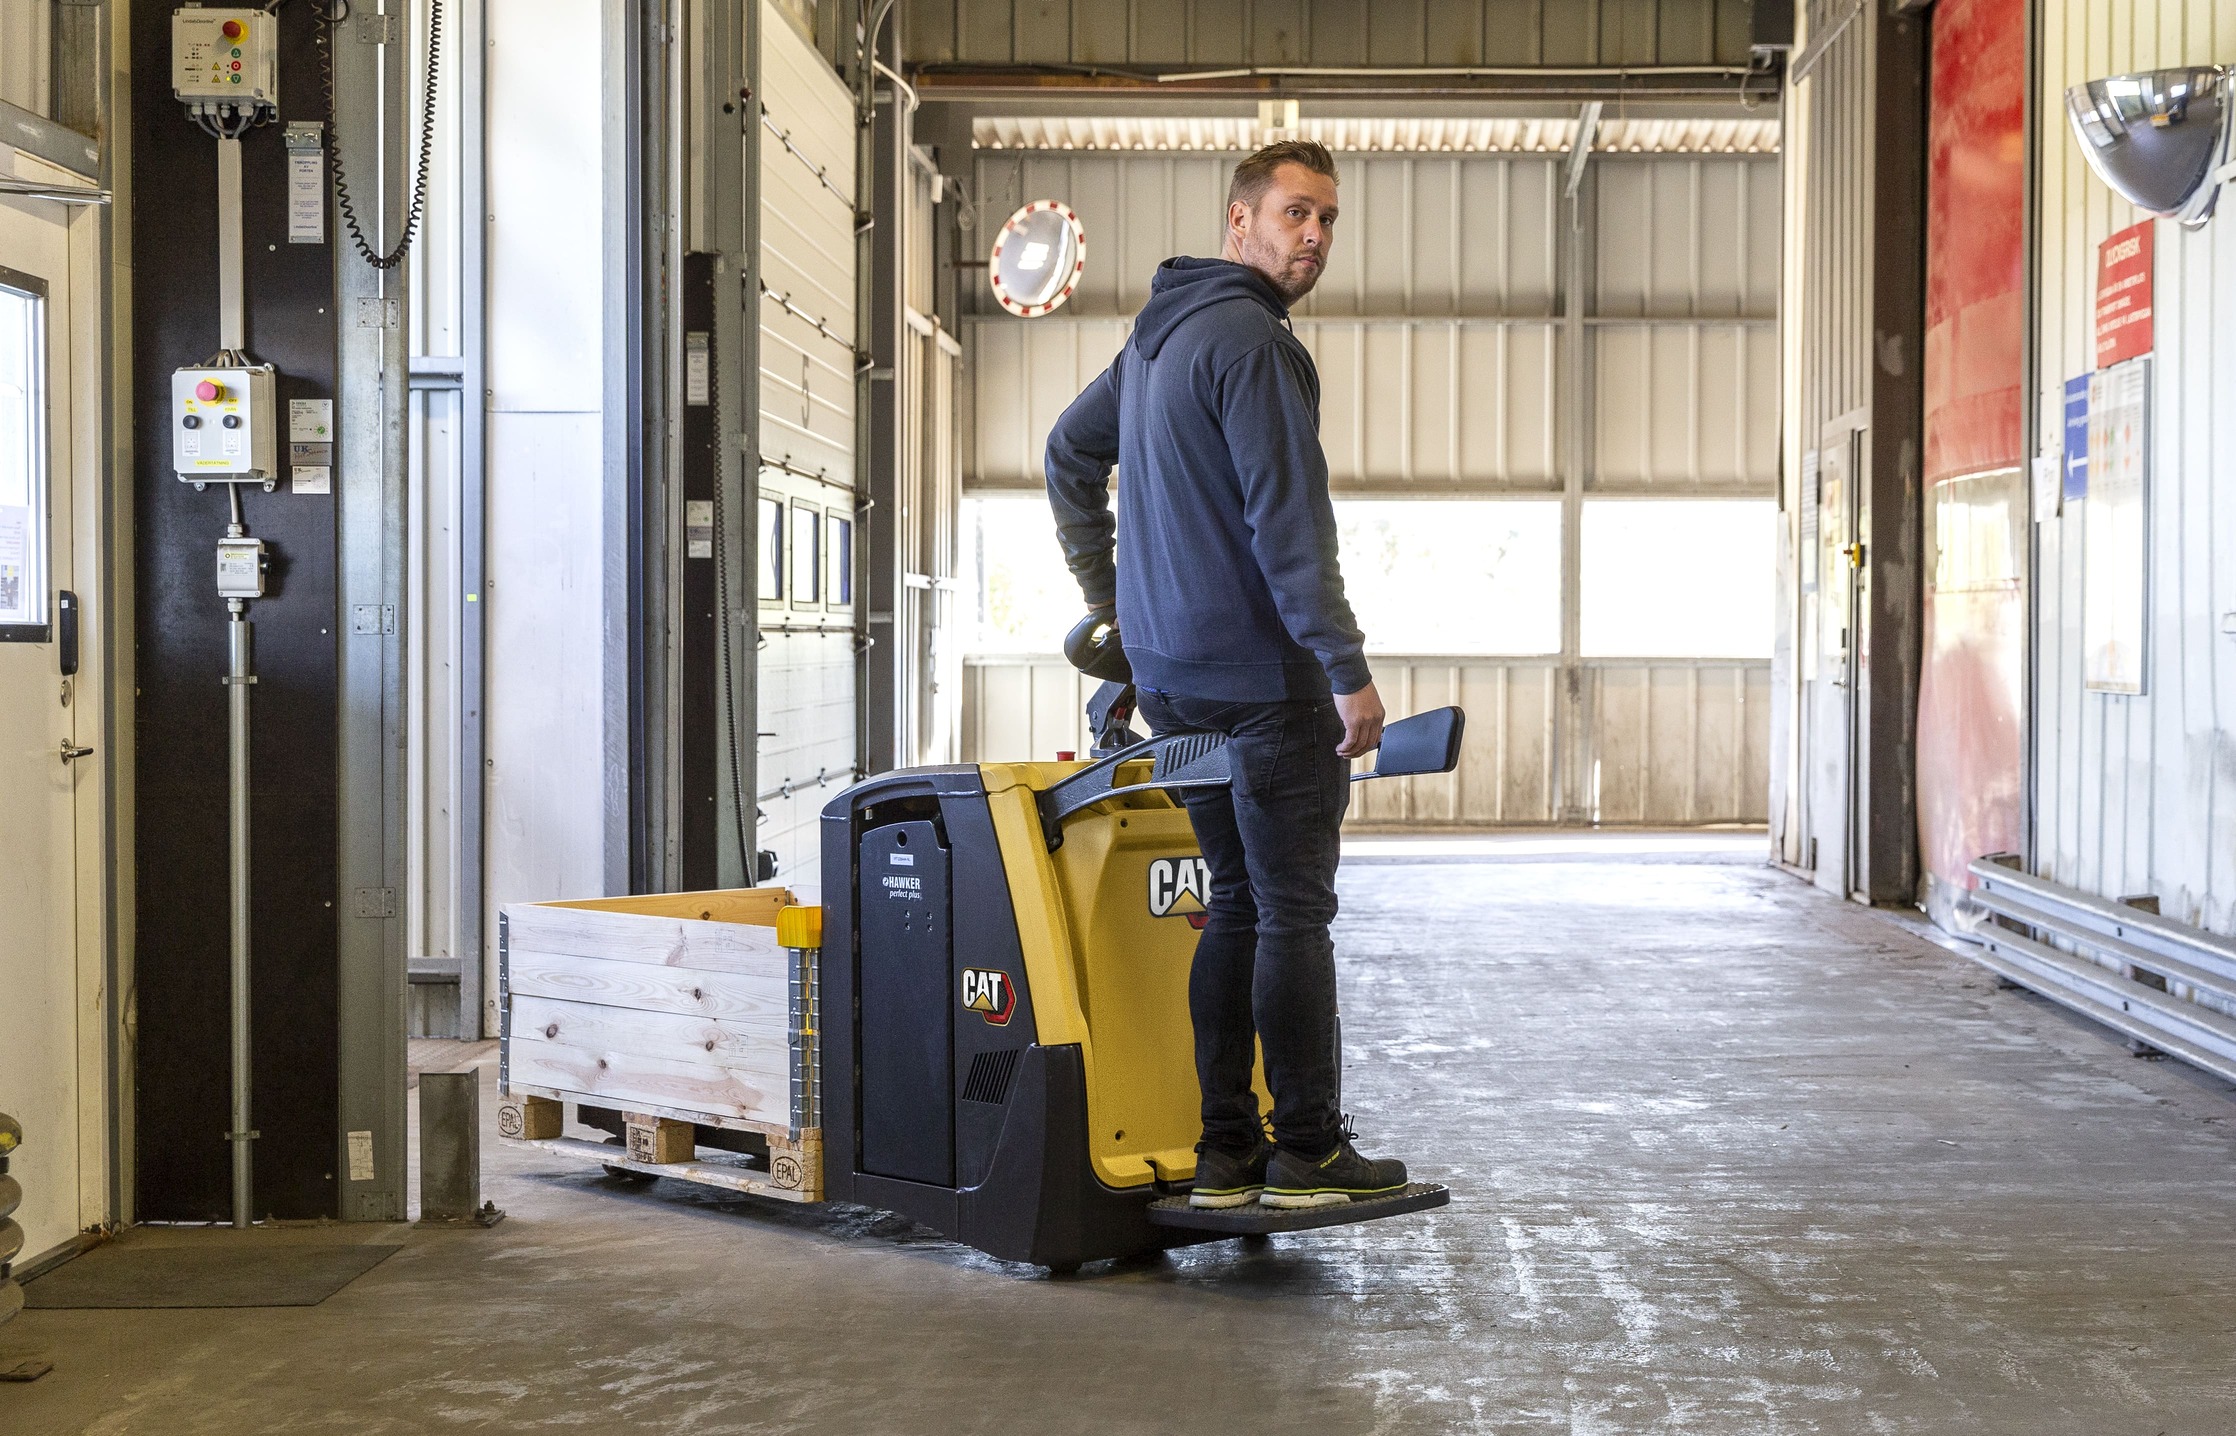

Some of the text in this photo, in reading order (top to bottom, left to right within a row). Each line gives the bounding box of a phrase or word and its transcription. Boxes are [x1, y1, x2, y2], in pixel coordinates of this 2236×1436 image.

[293, 445, 309, 453] UK
[889, 876, 921, 890] HAWKER
[1150, 858, 1212, 916] CAT
[889, 889, 920, 900] perfect plus
[963, 969, 1002, 1011] CAT
[776, 1162, 797, 1183] EPAL
